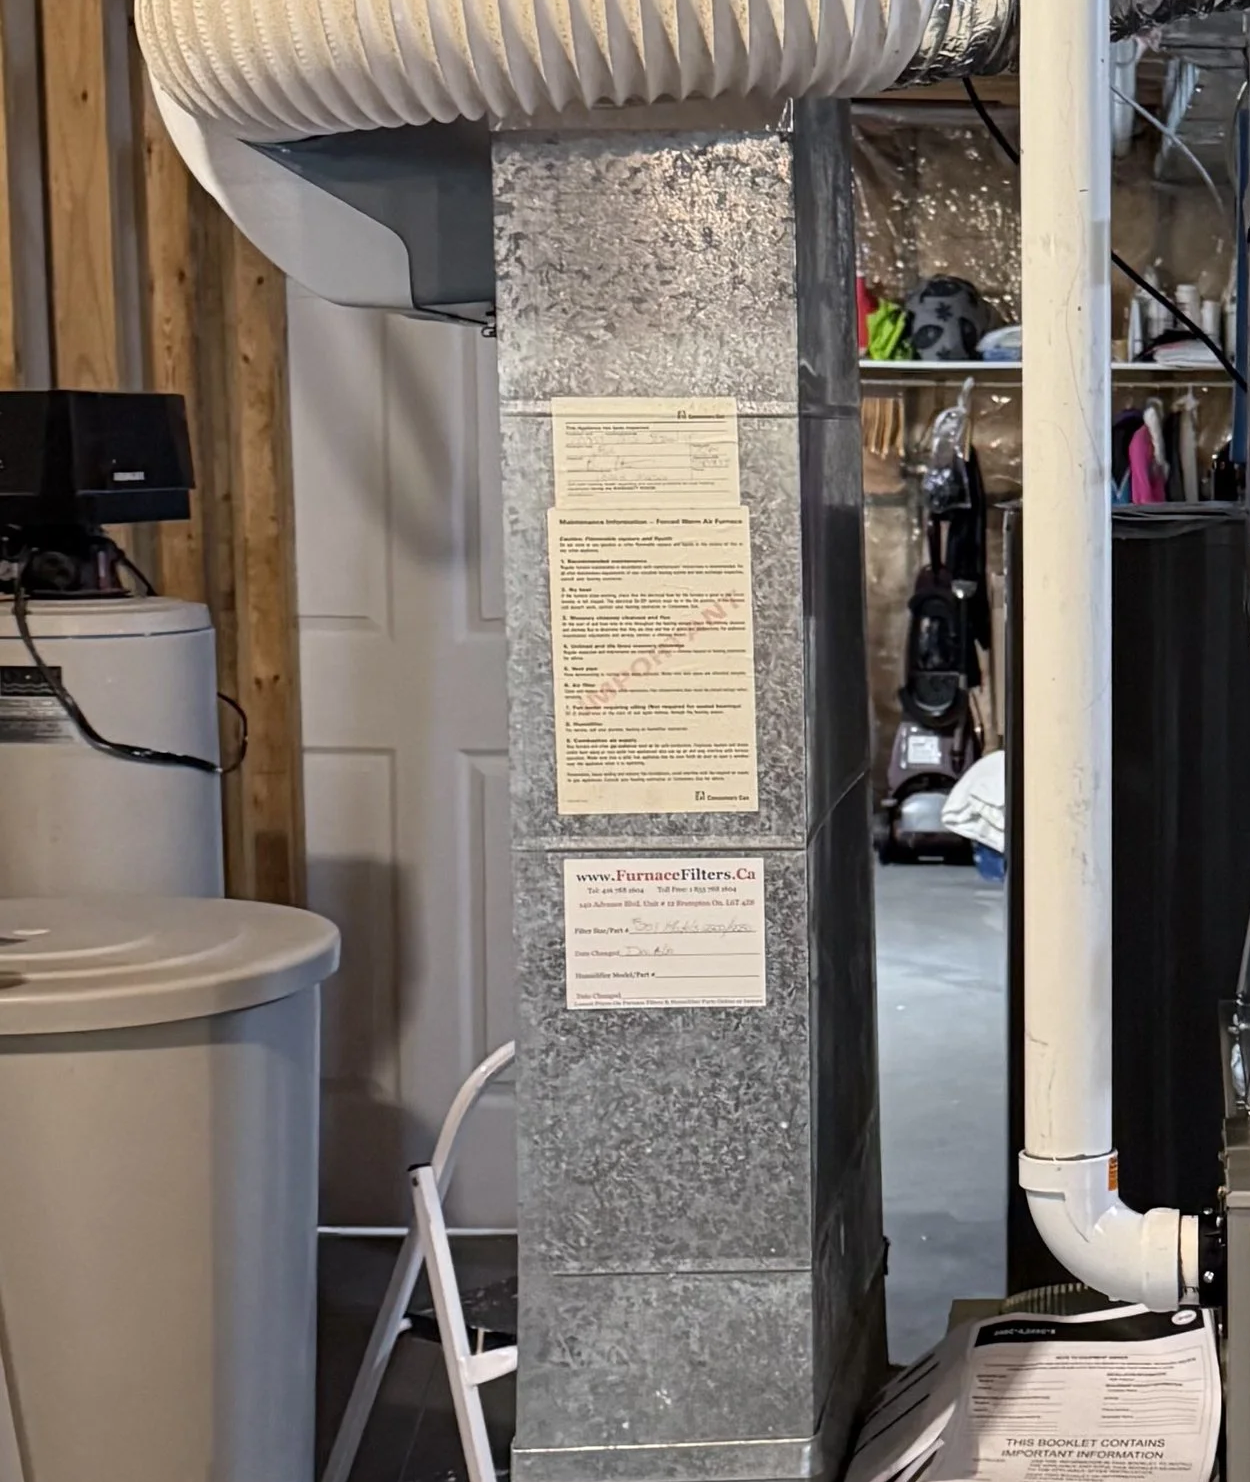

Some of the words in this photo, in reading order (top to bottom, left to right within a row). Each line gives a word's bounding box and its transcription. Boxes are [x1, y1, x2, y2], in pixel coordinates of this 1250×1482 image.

[576, 867, 756, 882] www.FurnaceFilters.Ca
[1006, 1438, 1034, 1447] THIS
[1038, 1438, 1097, 1447] BOOKLET
[1100, 1438, 1165, 1447] CONTAINS
[1001, 1449, 1074, 1458] IMPORTANT
[1076, 1450, 1164, 1459] INFORMATION
